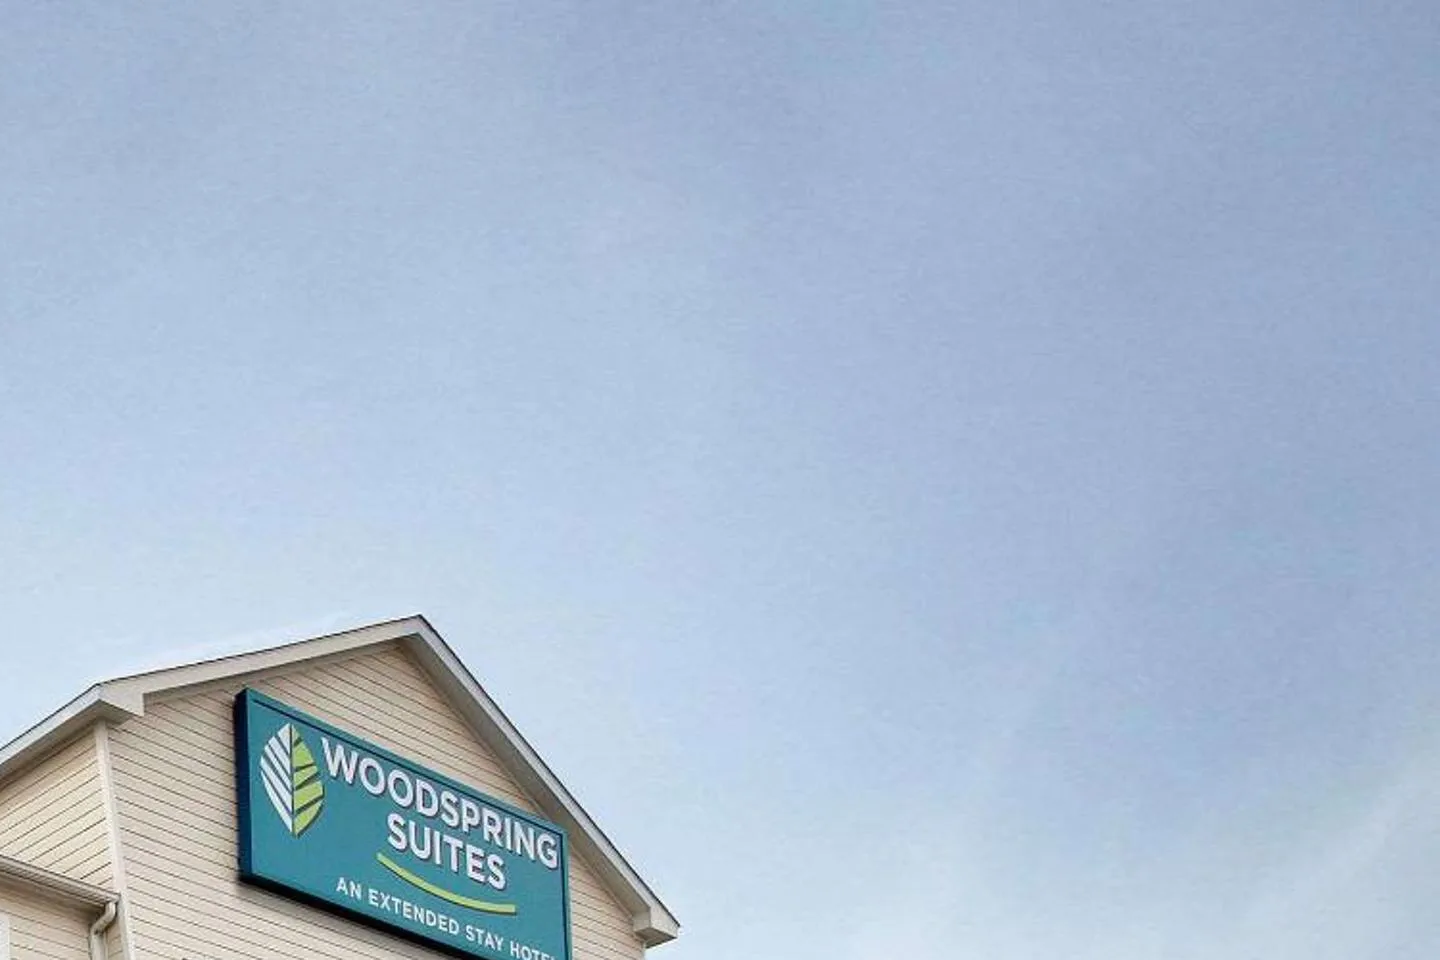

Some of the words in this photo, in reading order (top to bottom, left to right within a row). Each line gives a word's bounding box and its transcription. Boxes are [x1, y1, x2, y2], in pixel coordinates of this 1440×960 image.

[322, 737, 558, 868] WOODSPRING
[387, 813, 506, 890] SUITES
[336, 877, 361, 897] AN
[368, 888, 460, 935] EXTENDED
[465, 924, 504, 951] STAY
